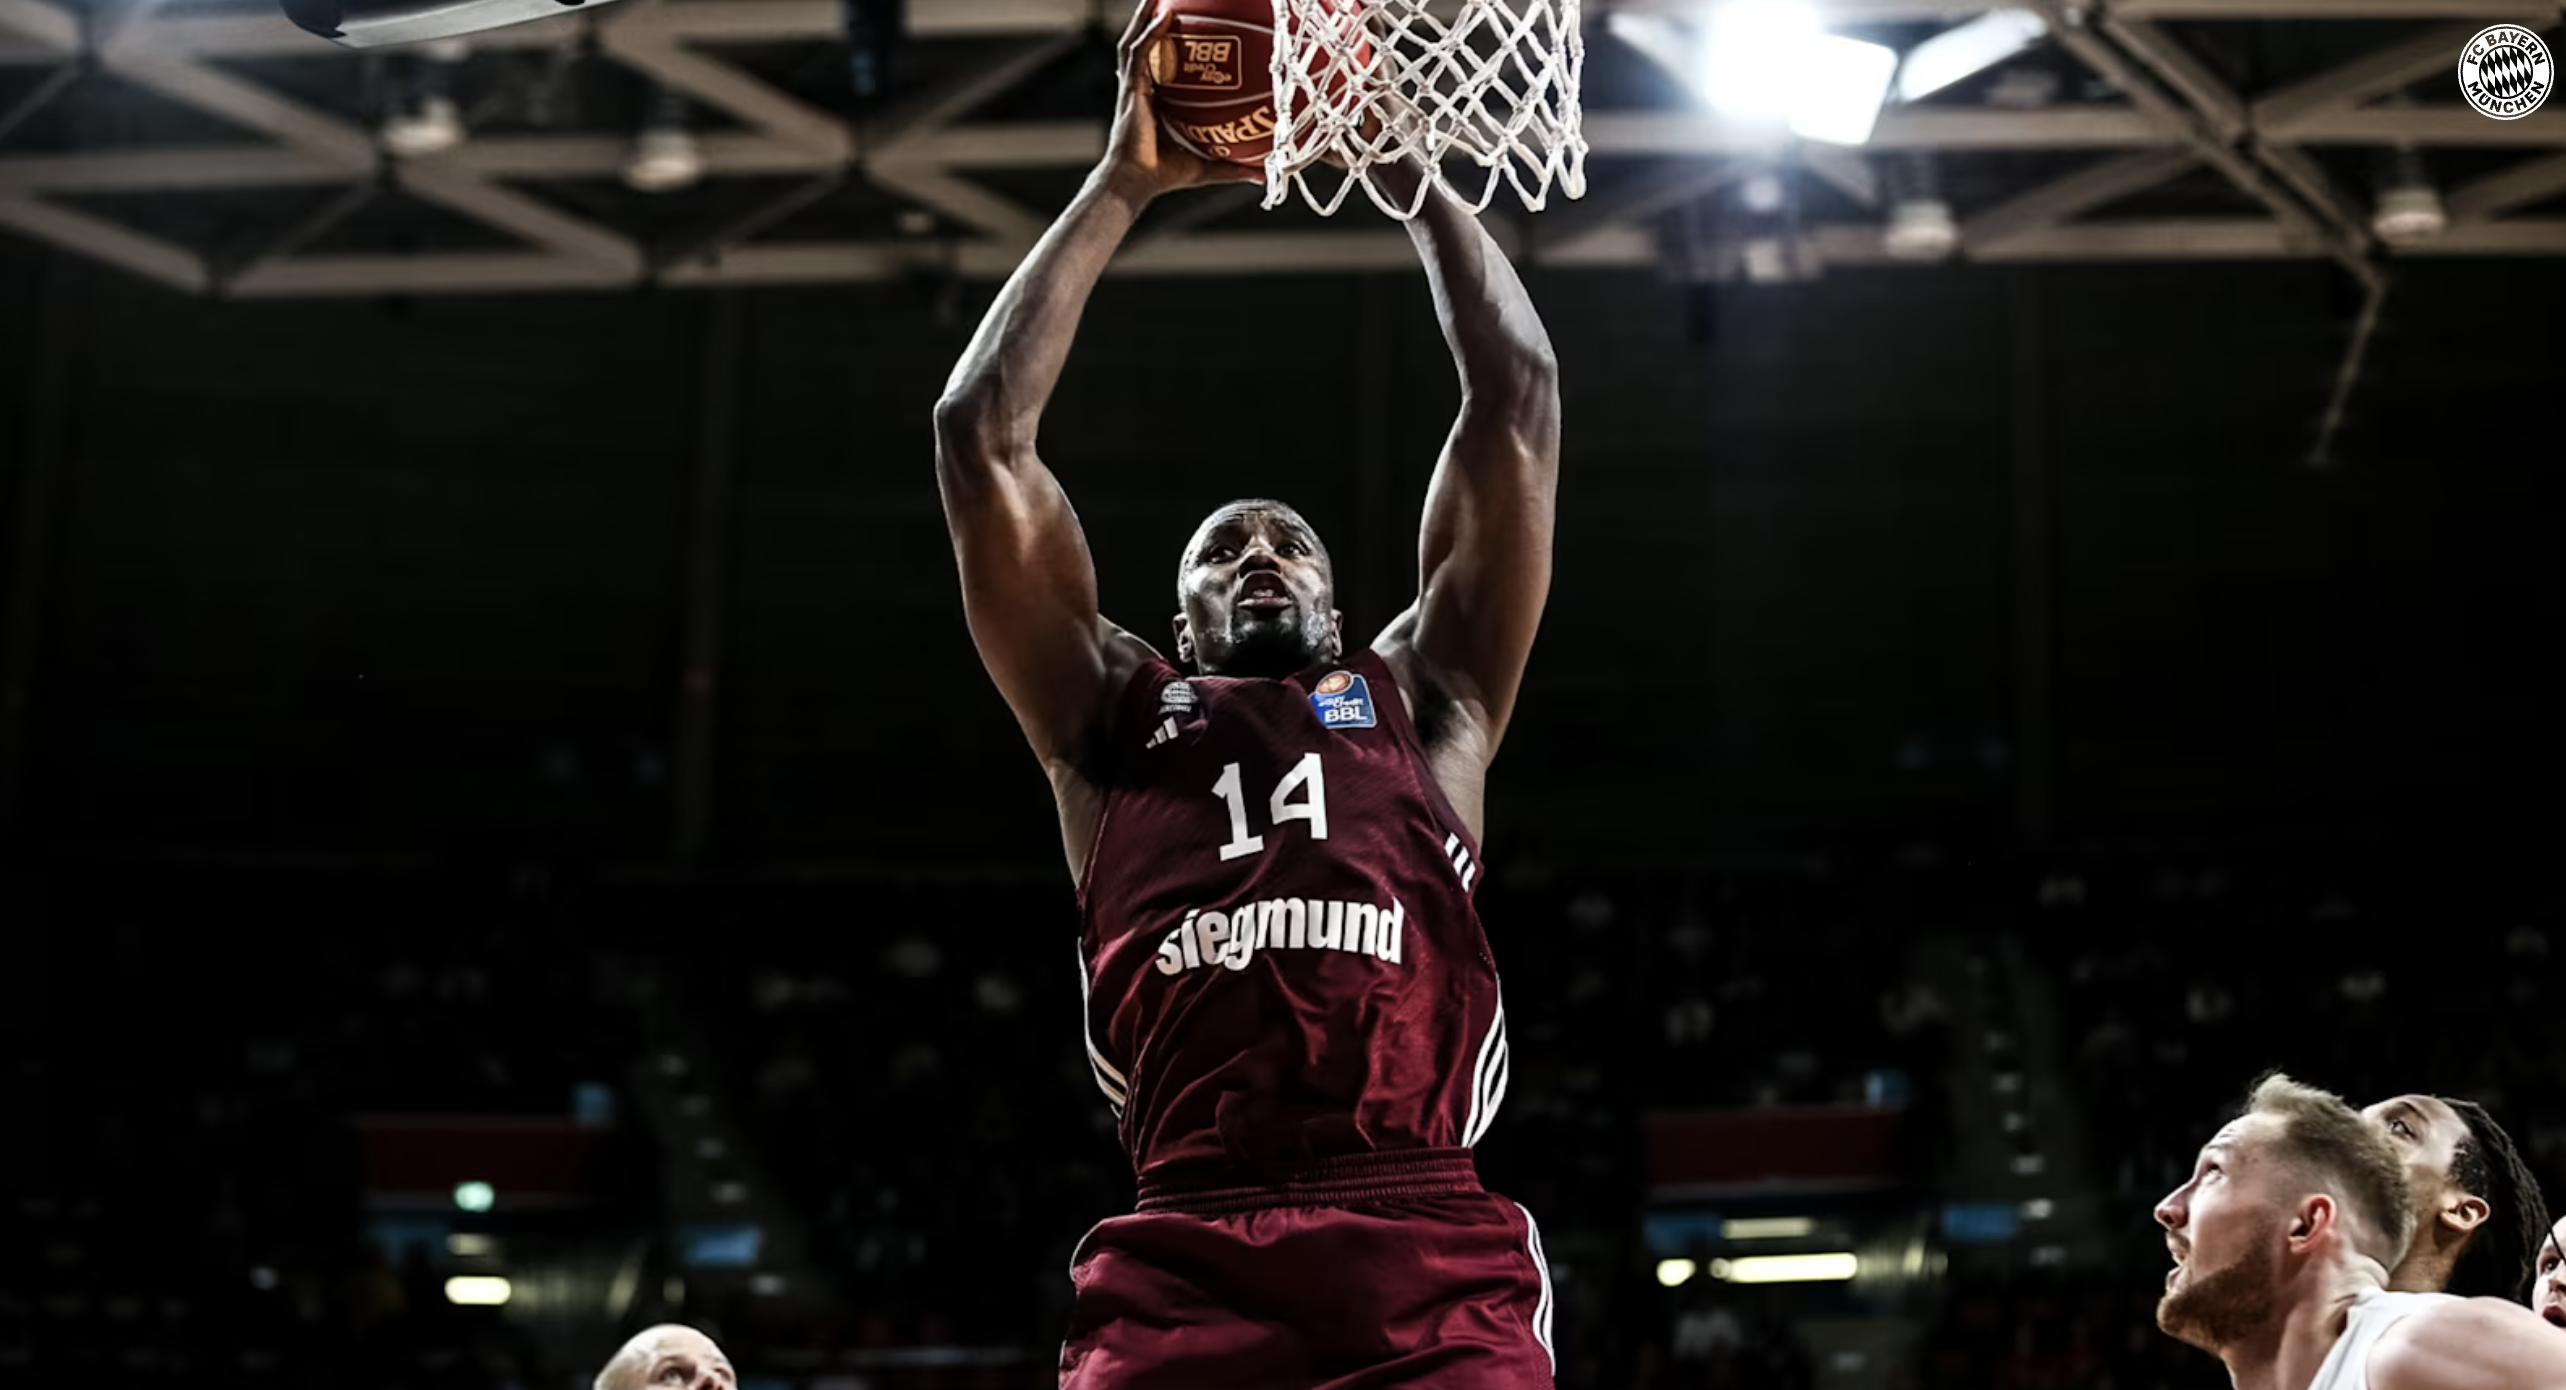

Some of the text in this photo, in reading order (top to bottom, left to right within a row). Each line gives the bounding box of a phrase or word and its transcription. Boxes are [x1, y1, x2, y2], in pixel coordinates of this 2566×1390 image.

[1184, 40, 1232, 63] BBL
[1324, 706, 1368, 723] BBL
[1211, 752, 1328, 862] 14
[1155, 895, 1404, 975] siegmund
